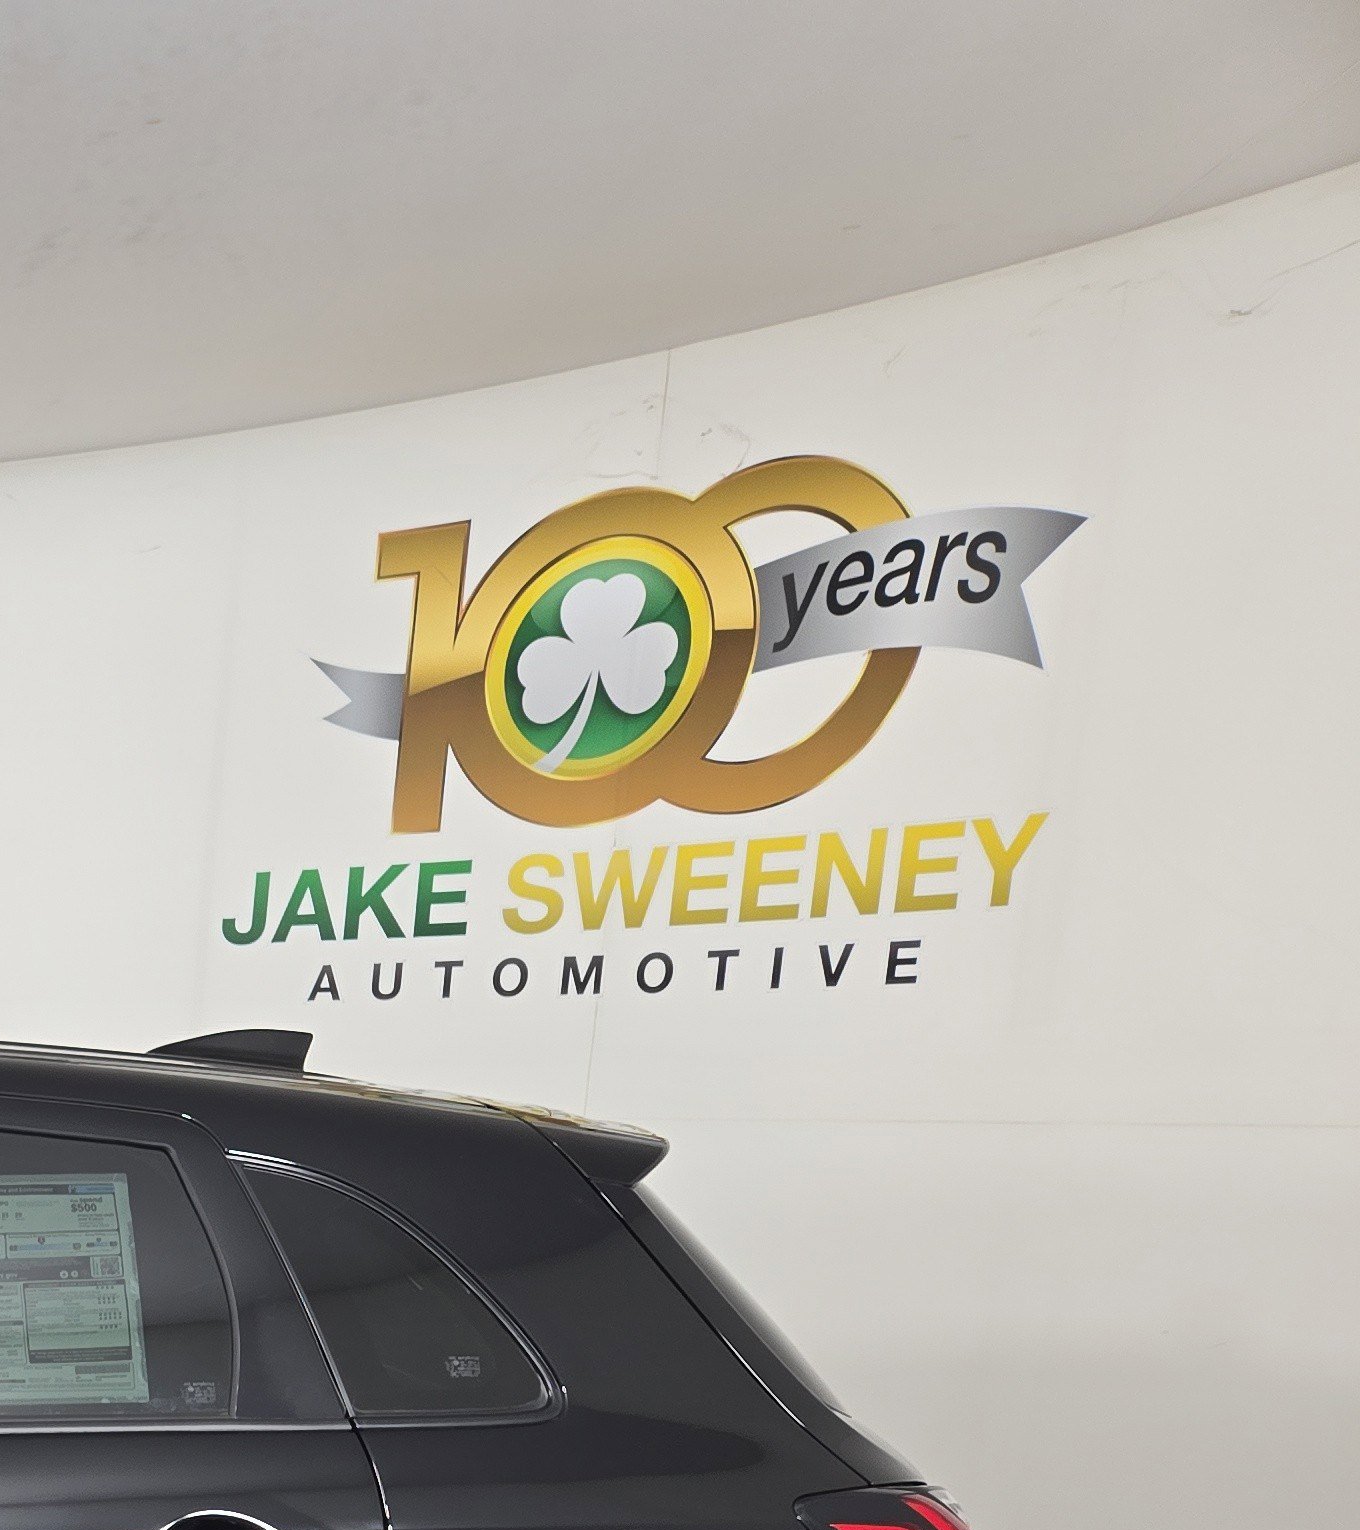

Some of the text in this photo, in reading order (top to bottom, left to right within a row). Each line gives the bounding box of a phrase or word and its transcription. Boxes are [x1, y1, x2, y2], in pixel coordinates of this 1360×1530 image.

[375, 453, 1007, 834] 100 years
[222, 812, 1049, 946] JAKE SWEENEY
[308, 940, 922, 1002] AUTOMOTIVE
